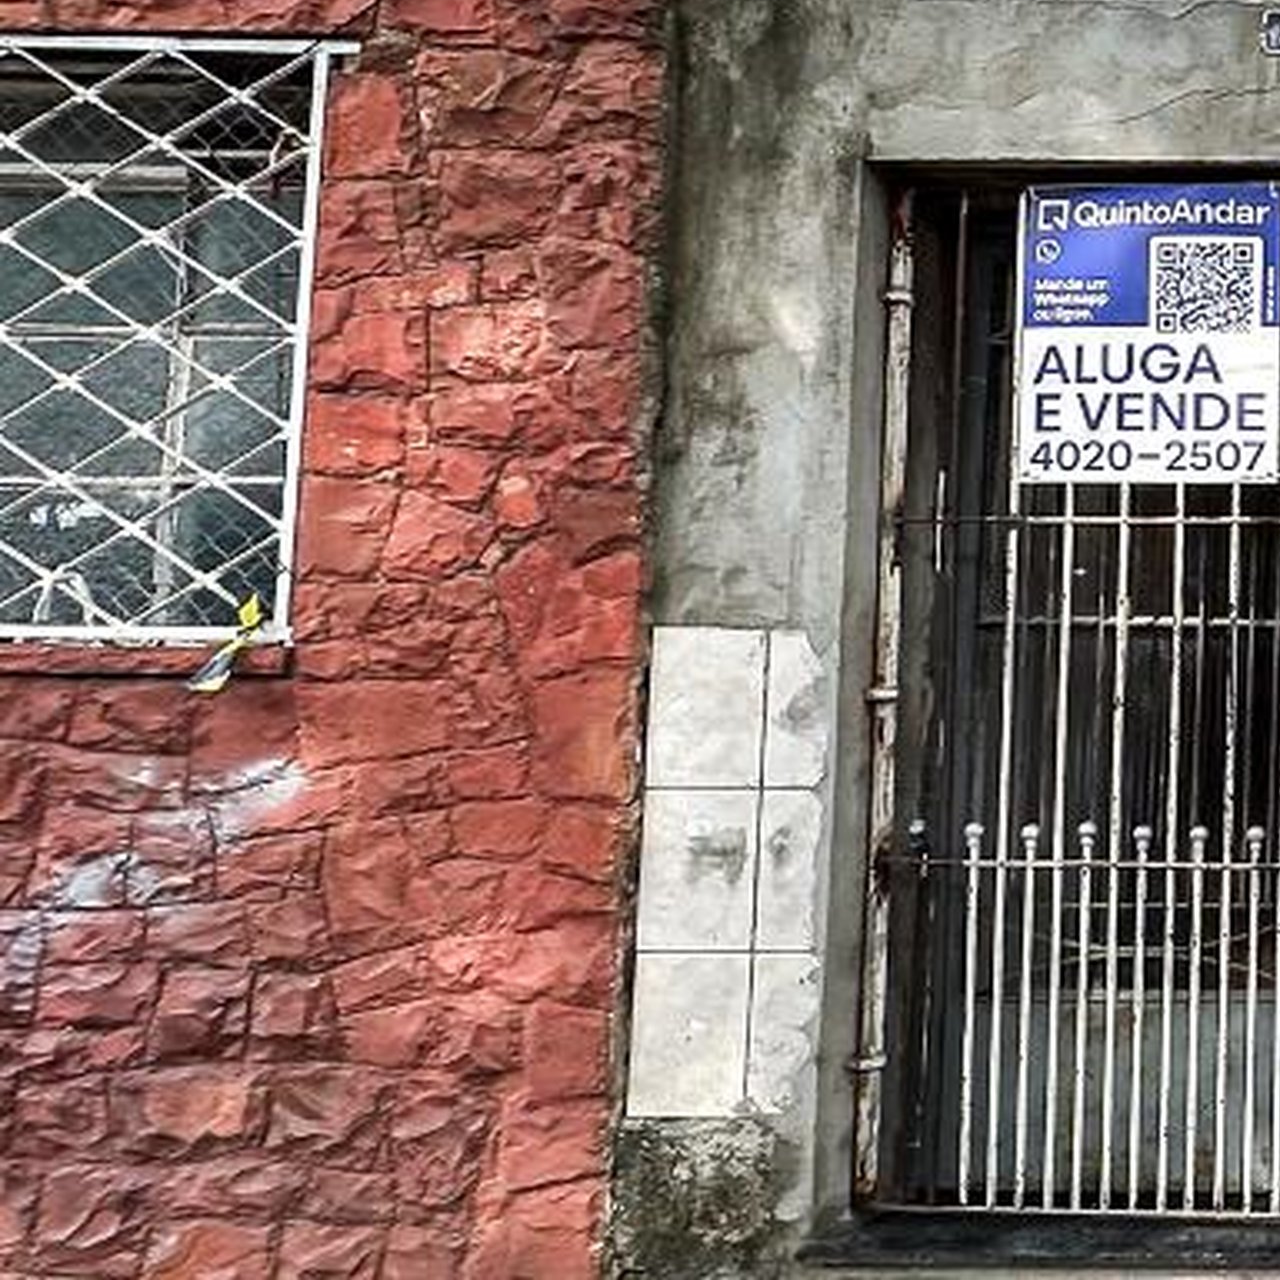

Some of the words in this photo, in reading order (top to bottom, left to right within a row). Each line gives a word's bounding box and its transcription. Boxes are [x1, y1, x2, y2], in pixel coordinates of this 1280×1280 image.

[1073, 198, 1271, 227] QuintoAndar
[1033, 343, 1223, 384] ALUGA
[1035, 392, 1062, 432] E
[1076, 391, 1267, 432] VENDE
[1030, 439, 1266, 472] 4020-2507
